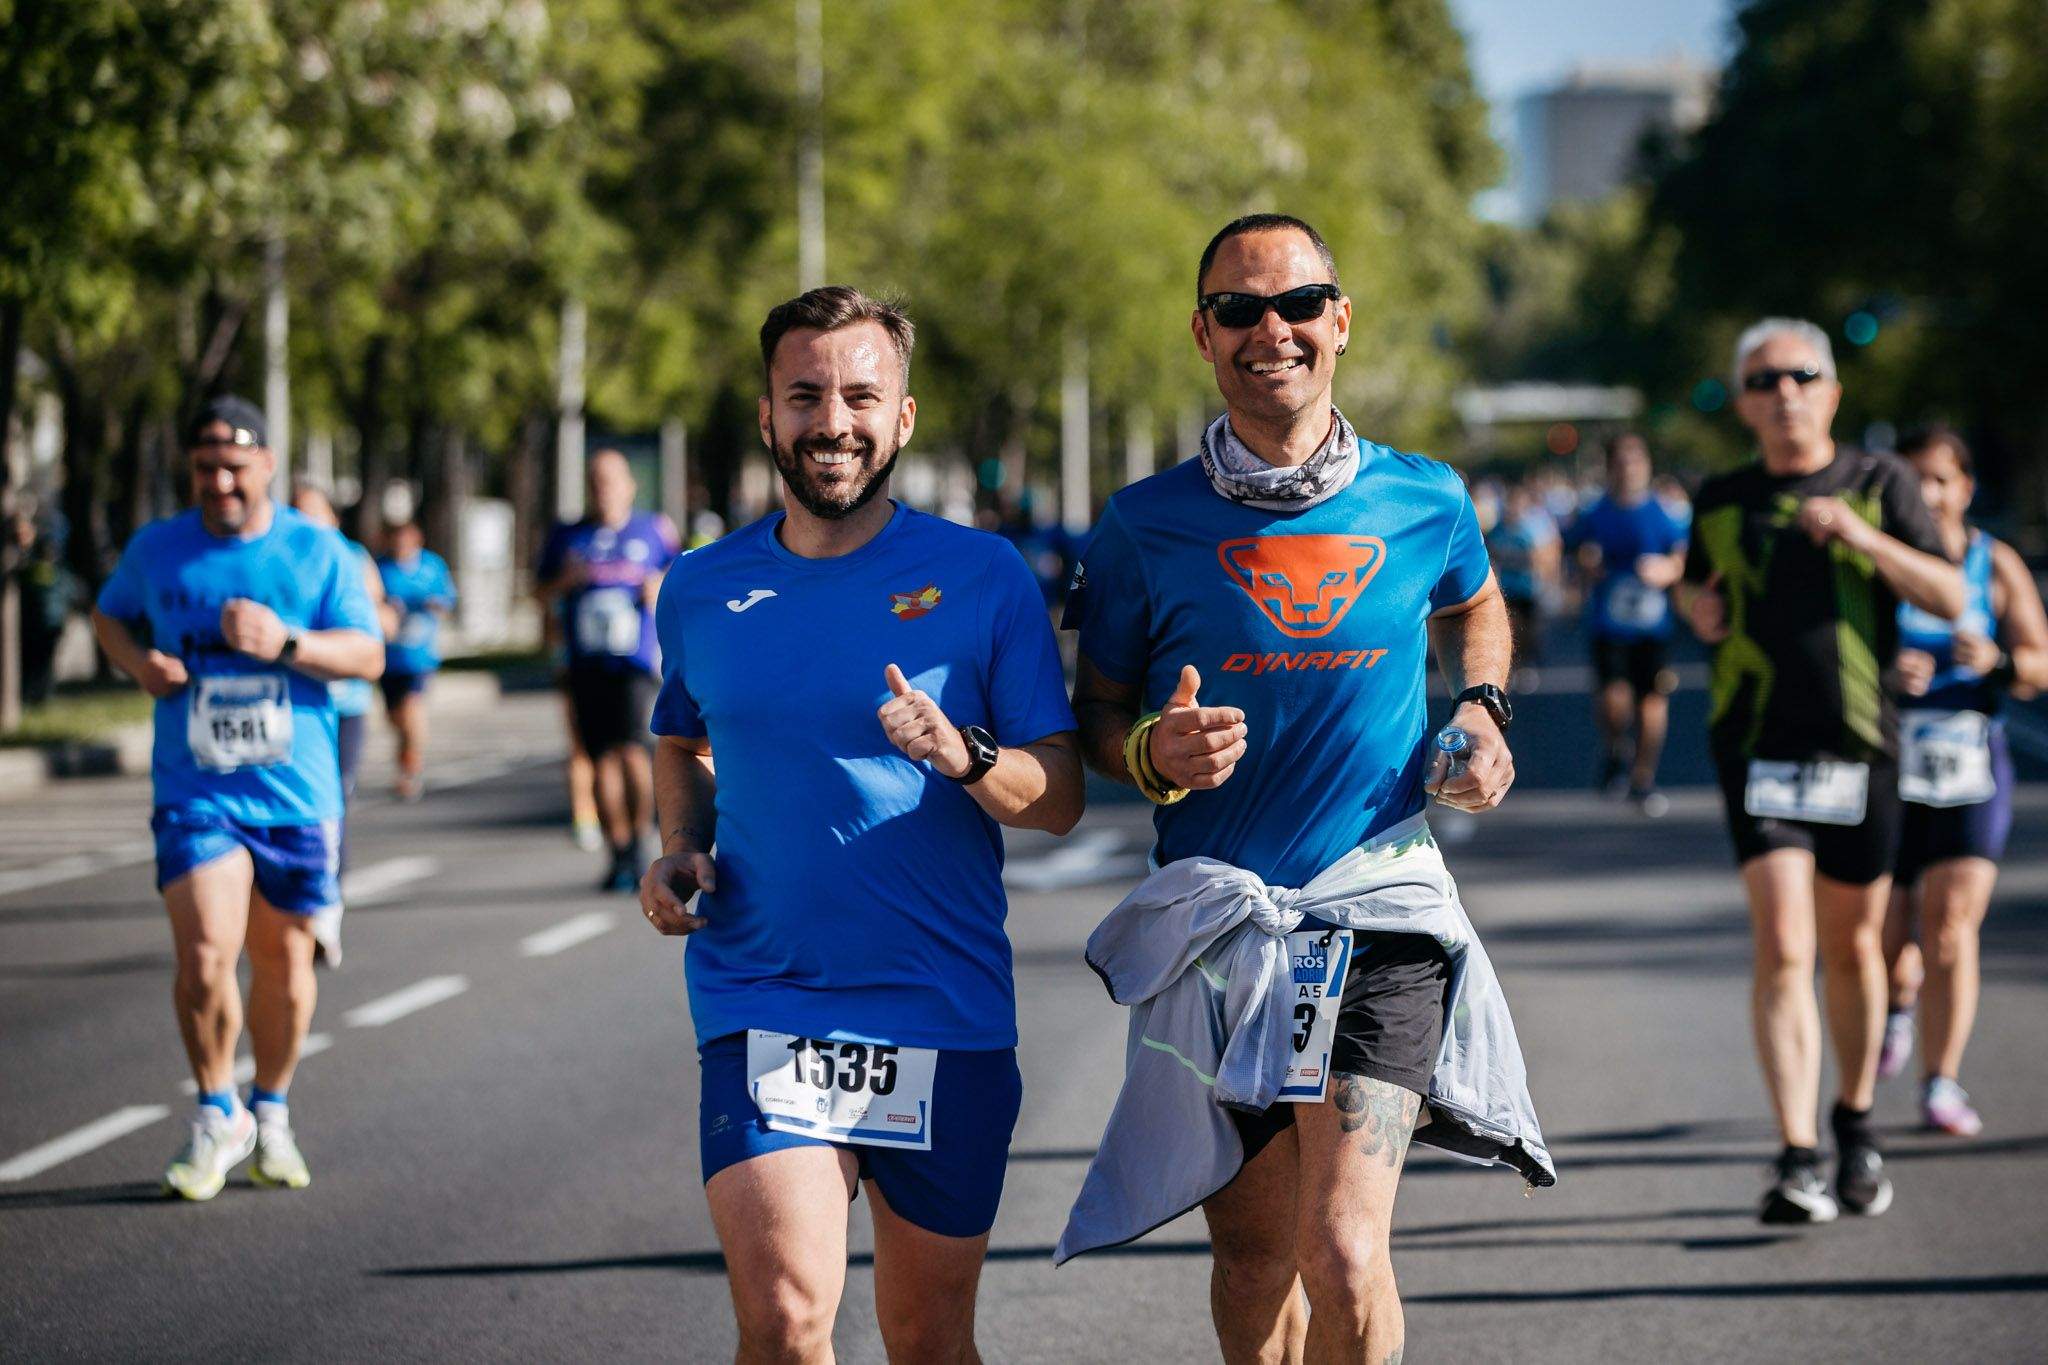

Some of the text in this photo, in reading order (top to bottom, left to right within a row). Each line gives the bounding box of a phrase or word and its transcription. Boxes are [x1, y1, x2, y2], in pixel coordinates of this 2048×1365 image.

[1221, 649, 1388, 676] DYNAFIT
[1293, 956, 1325, 969] ROS
[787, 1037, 898, 1095] 1535
